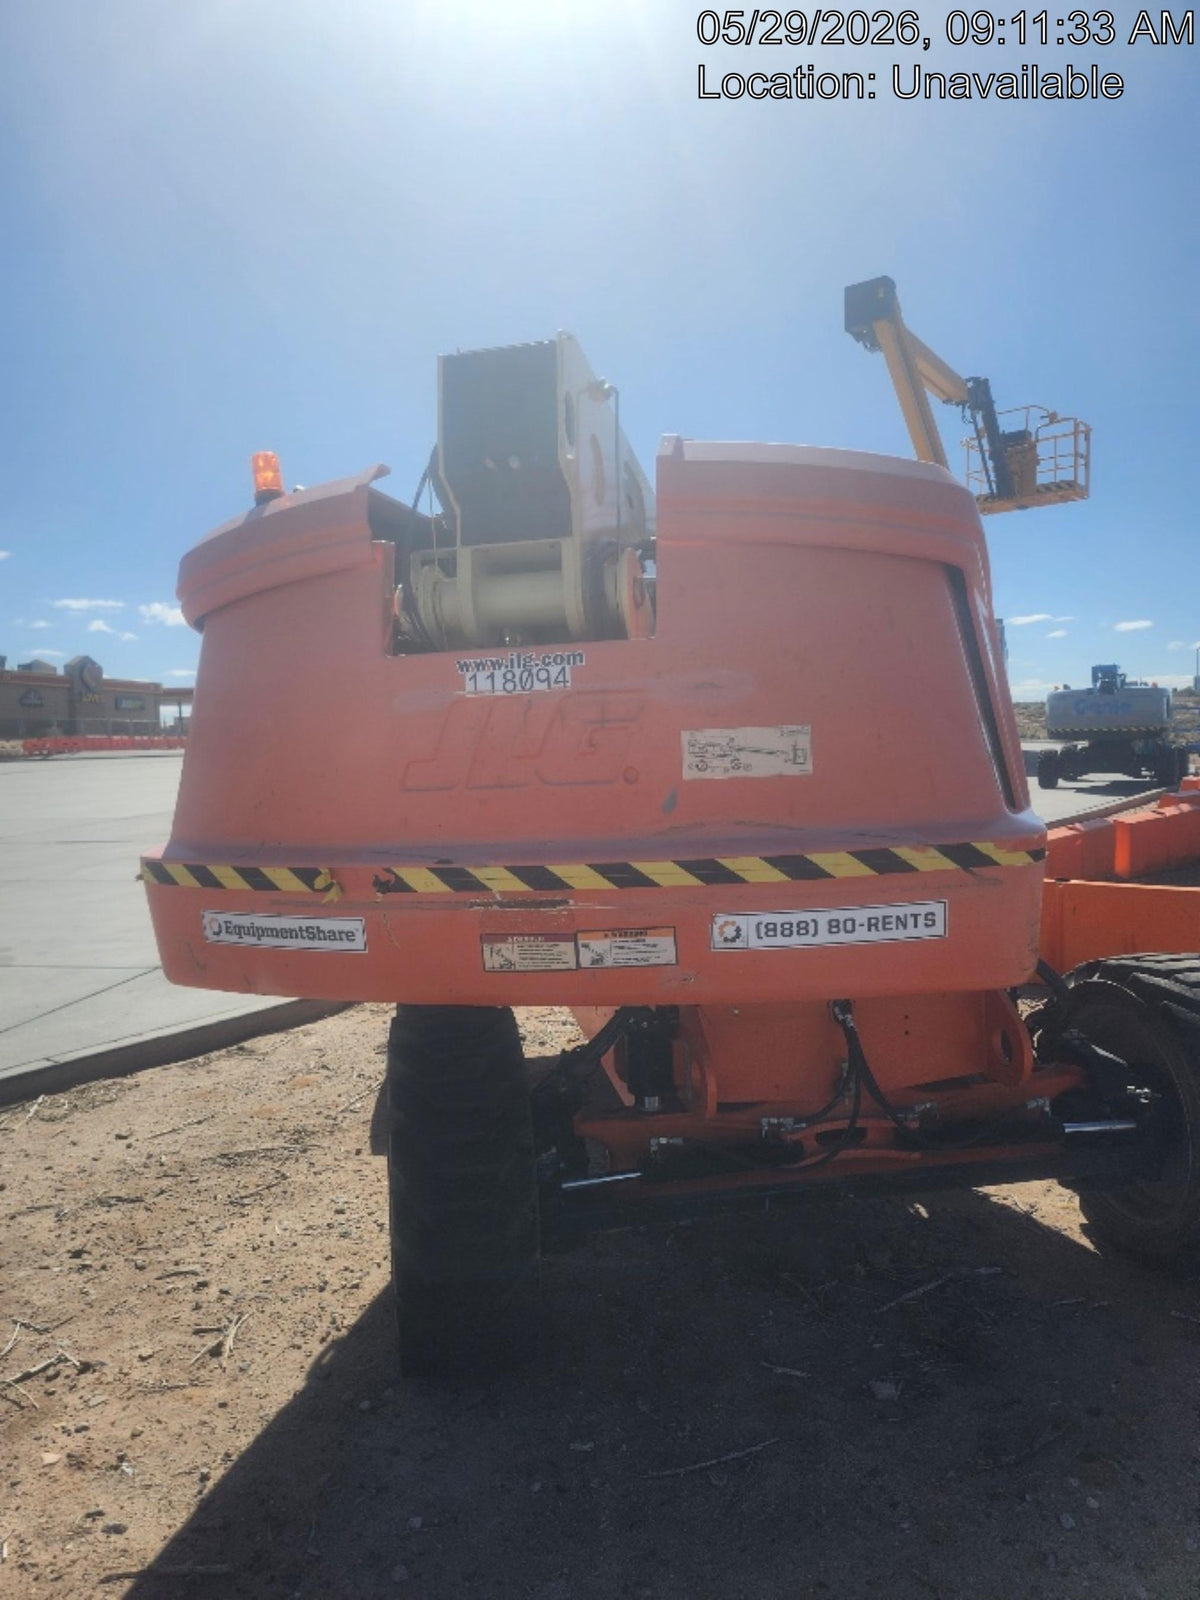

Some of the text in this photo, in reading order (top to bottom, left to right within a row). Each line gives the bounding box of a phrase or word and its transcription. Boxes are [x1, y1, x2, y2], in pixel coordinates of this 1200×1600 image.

[468, 666, 569, 694] 118094
[223, 920, 357, 942] EquipmentShare
[755, 911, 937, 940] (888) 80-RENTS
